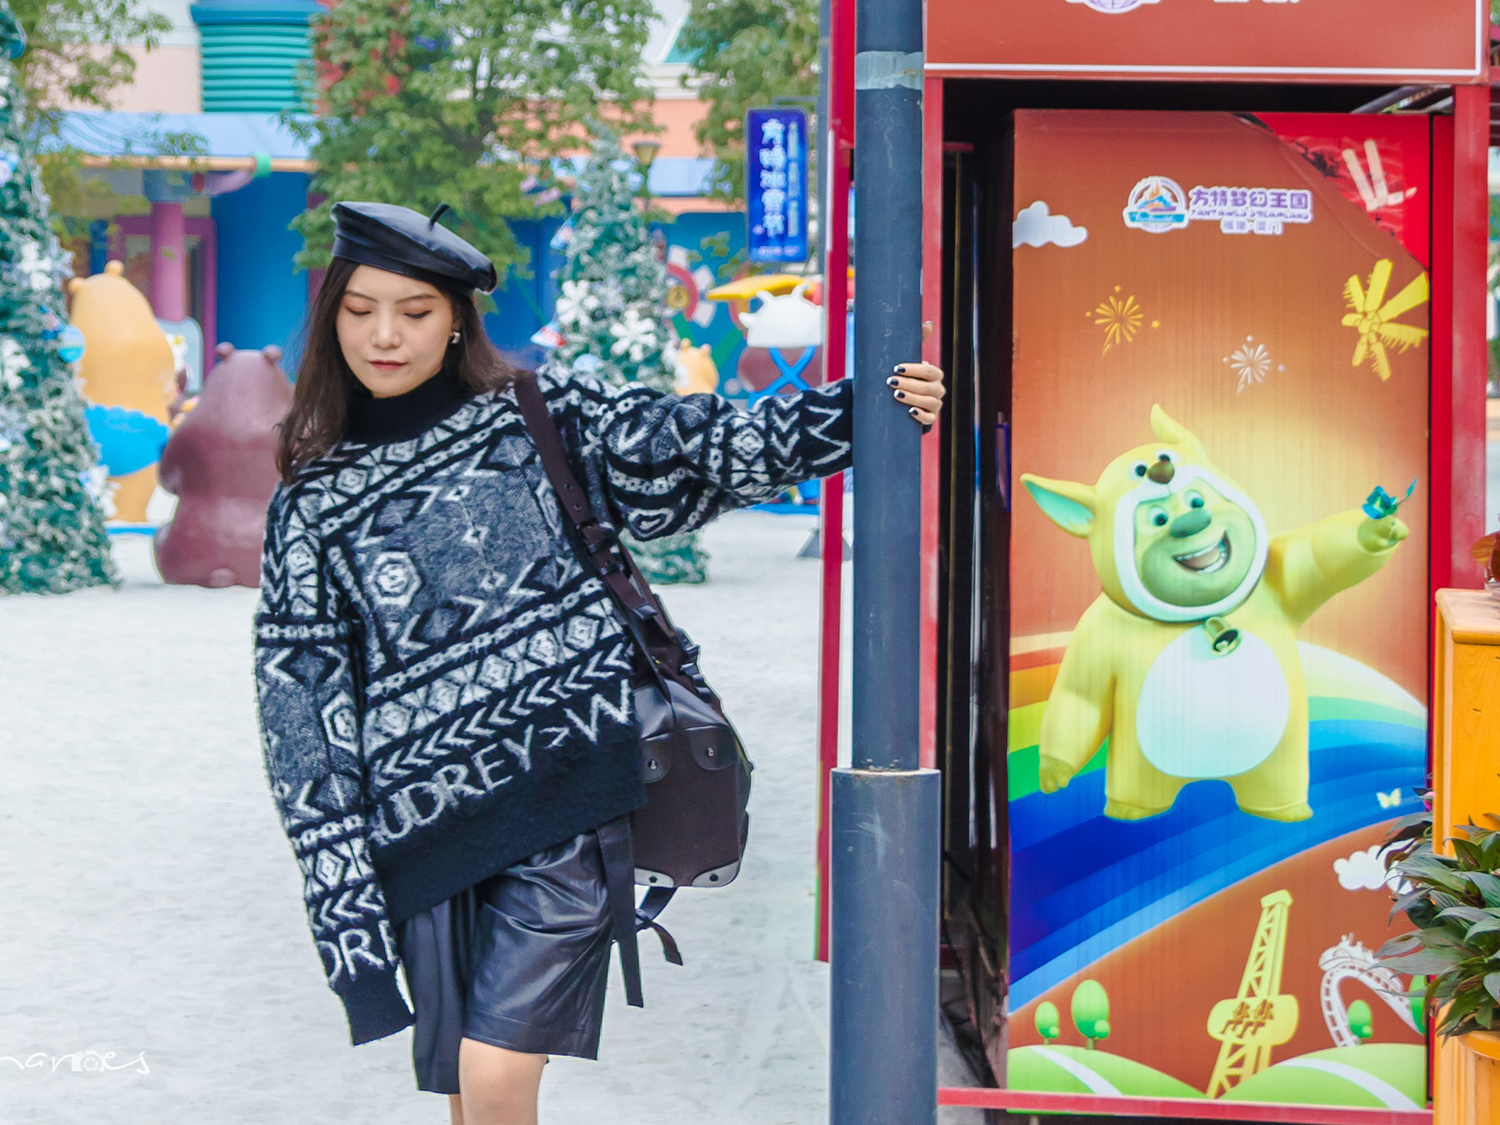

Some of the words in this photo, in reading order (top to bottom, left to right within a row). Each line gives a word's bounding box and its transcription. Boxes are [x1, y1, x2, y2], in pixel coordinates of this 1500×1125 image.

[1190, 187, 1310, 210] 方特梦幻王国
